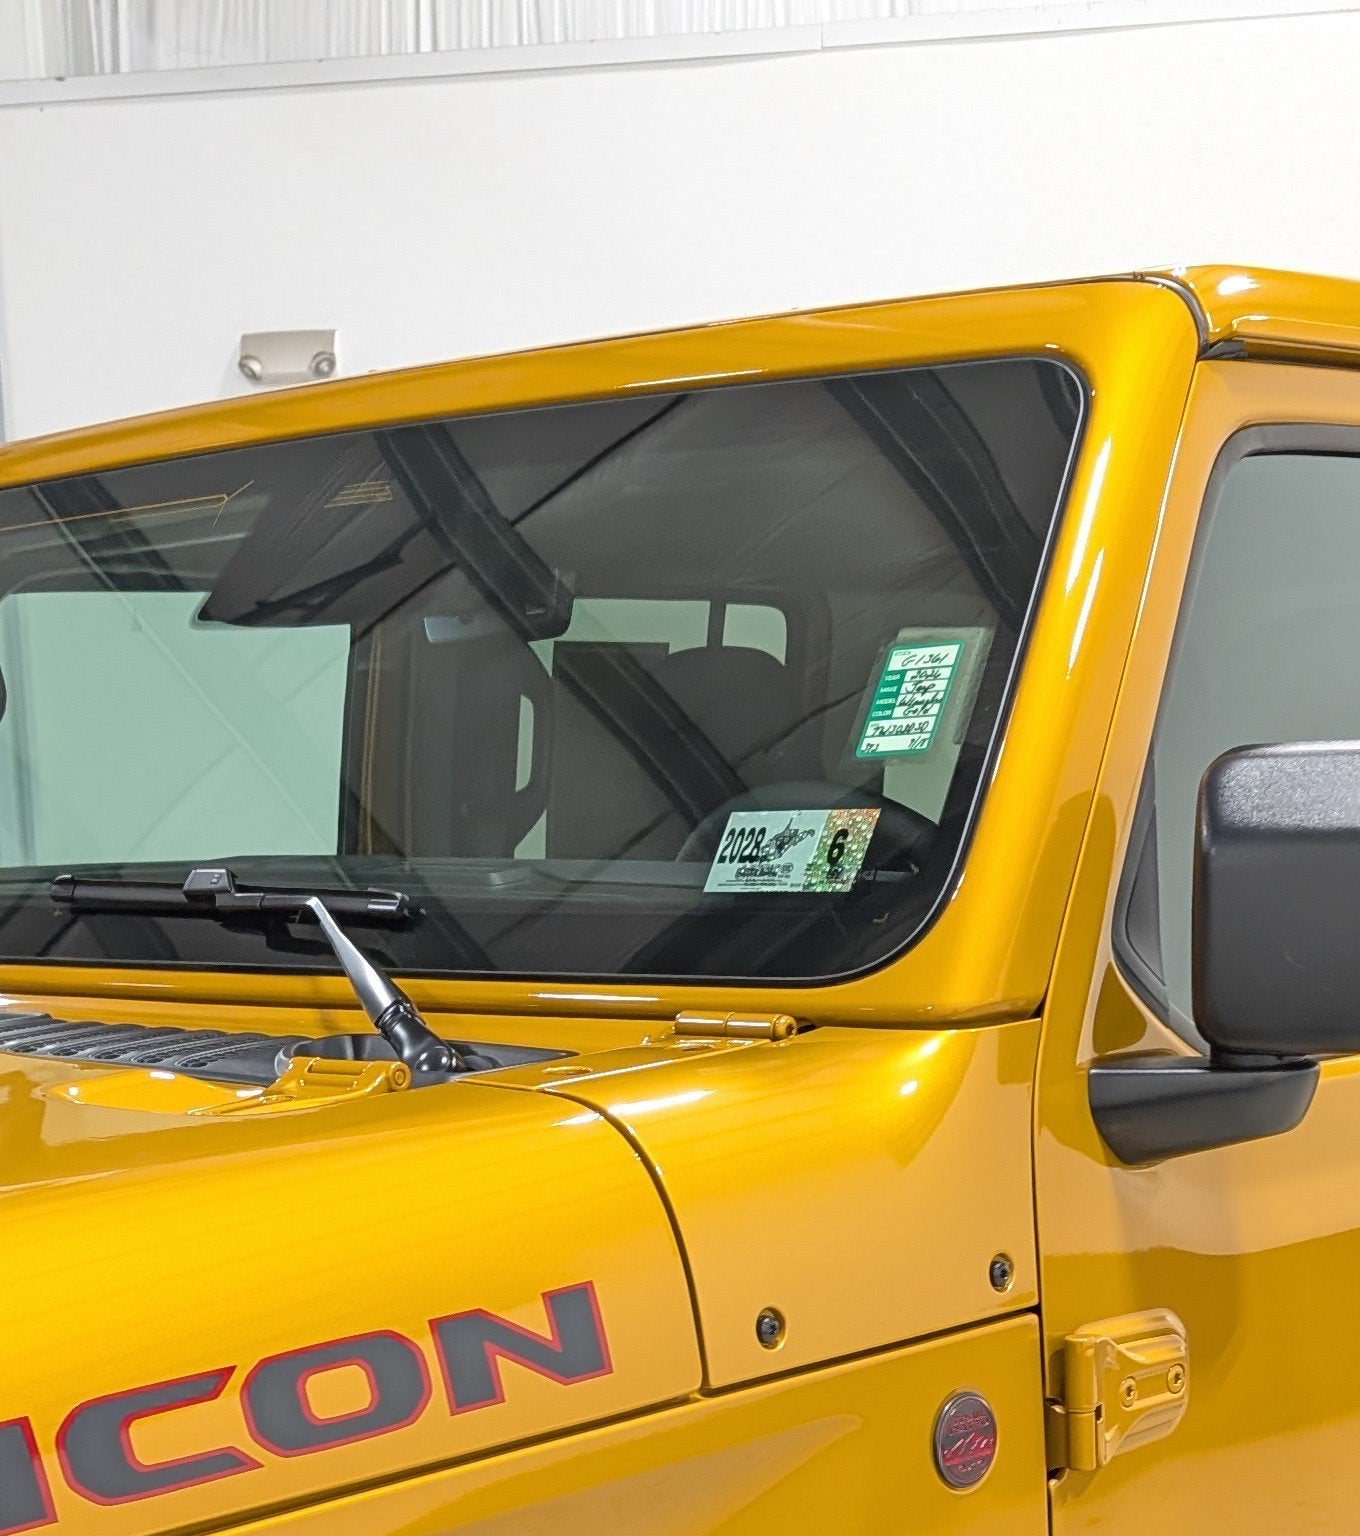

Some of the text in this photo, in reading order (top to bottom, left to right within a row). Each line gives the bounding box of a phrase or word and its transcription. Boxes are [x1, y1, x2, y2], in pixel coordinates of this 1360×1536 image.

[875, 697, 896, 705] MODEL
[871, 709, 892, 717] COLOR
[716, 826, 767, 864] 2028
[827, 828, 850, 866] 6
